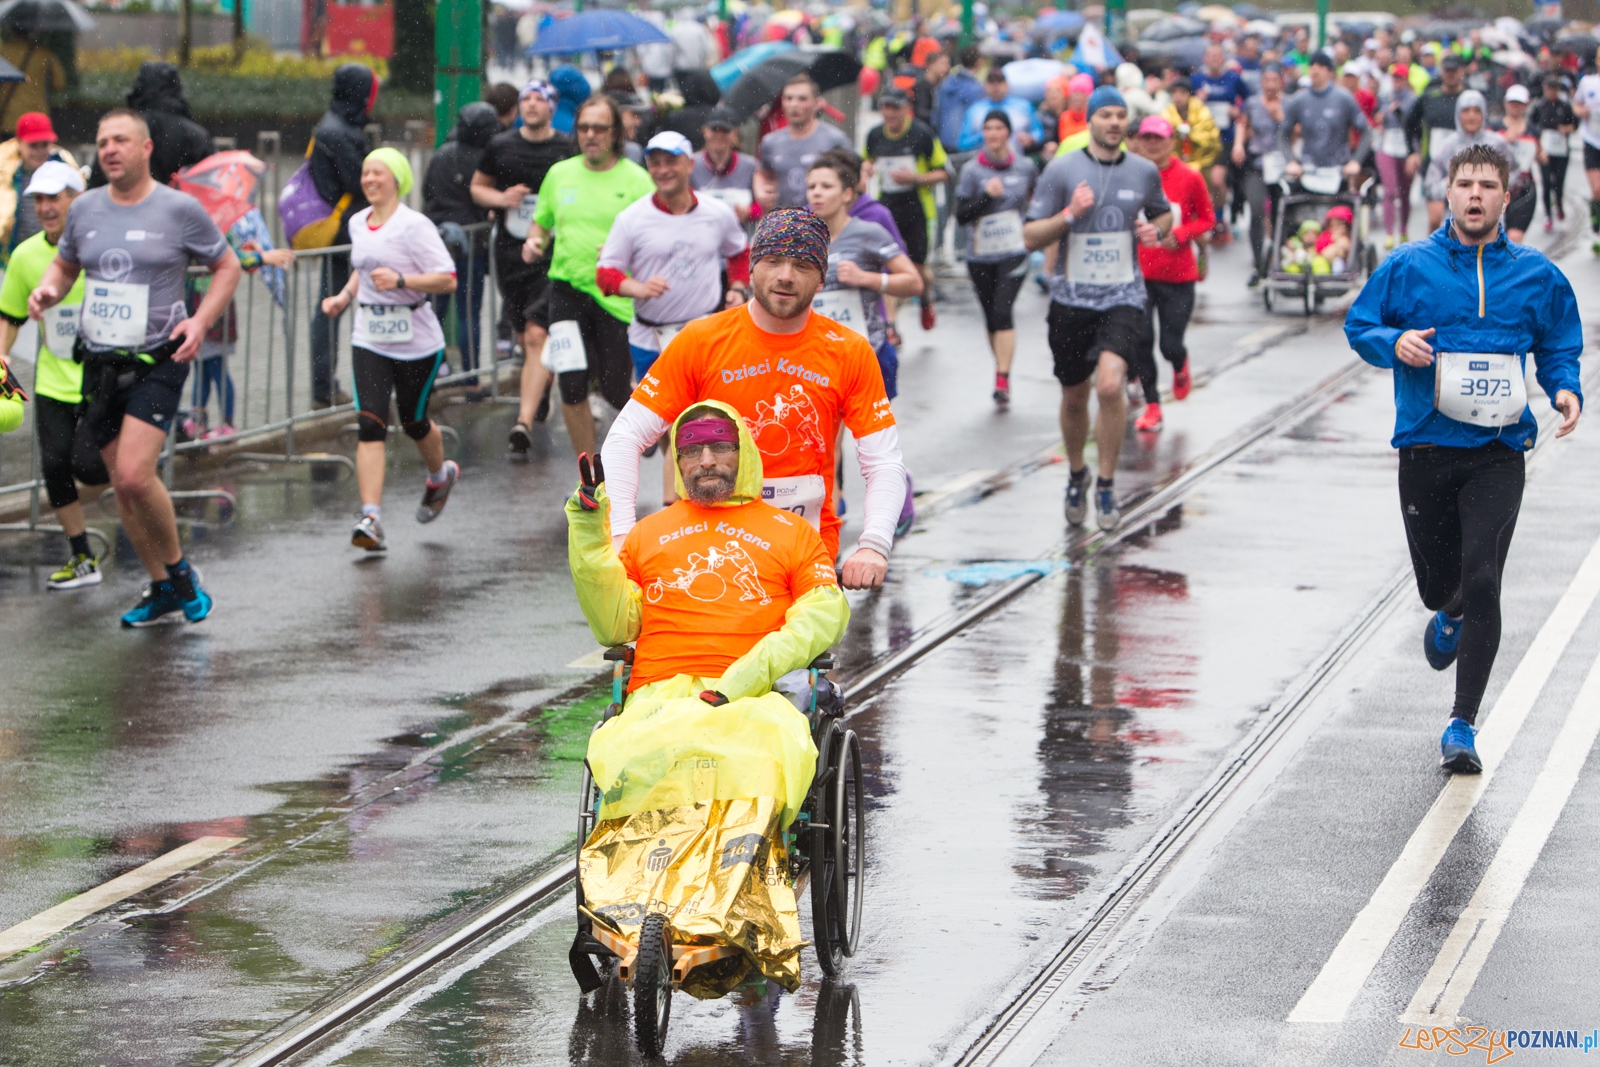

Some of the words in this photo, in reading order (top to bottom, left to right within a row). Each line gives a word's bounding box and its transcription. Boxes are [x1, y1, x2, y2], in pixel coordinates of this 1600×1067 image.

[1083, 249, 1121, 263] 2651
[89, 302, 132, 320] 4870
[368, 319, 409, 334] 8520
[721, 358, 771, 384] Dzieci
[776, 357, 830, 387] Kotana
[1460, 378, 1512, 397] 3973
[659, 521, 709, 545] Dzieci
[714, 521, 771, 550] Kotana
